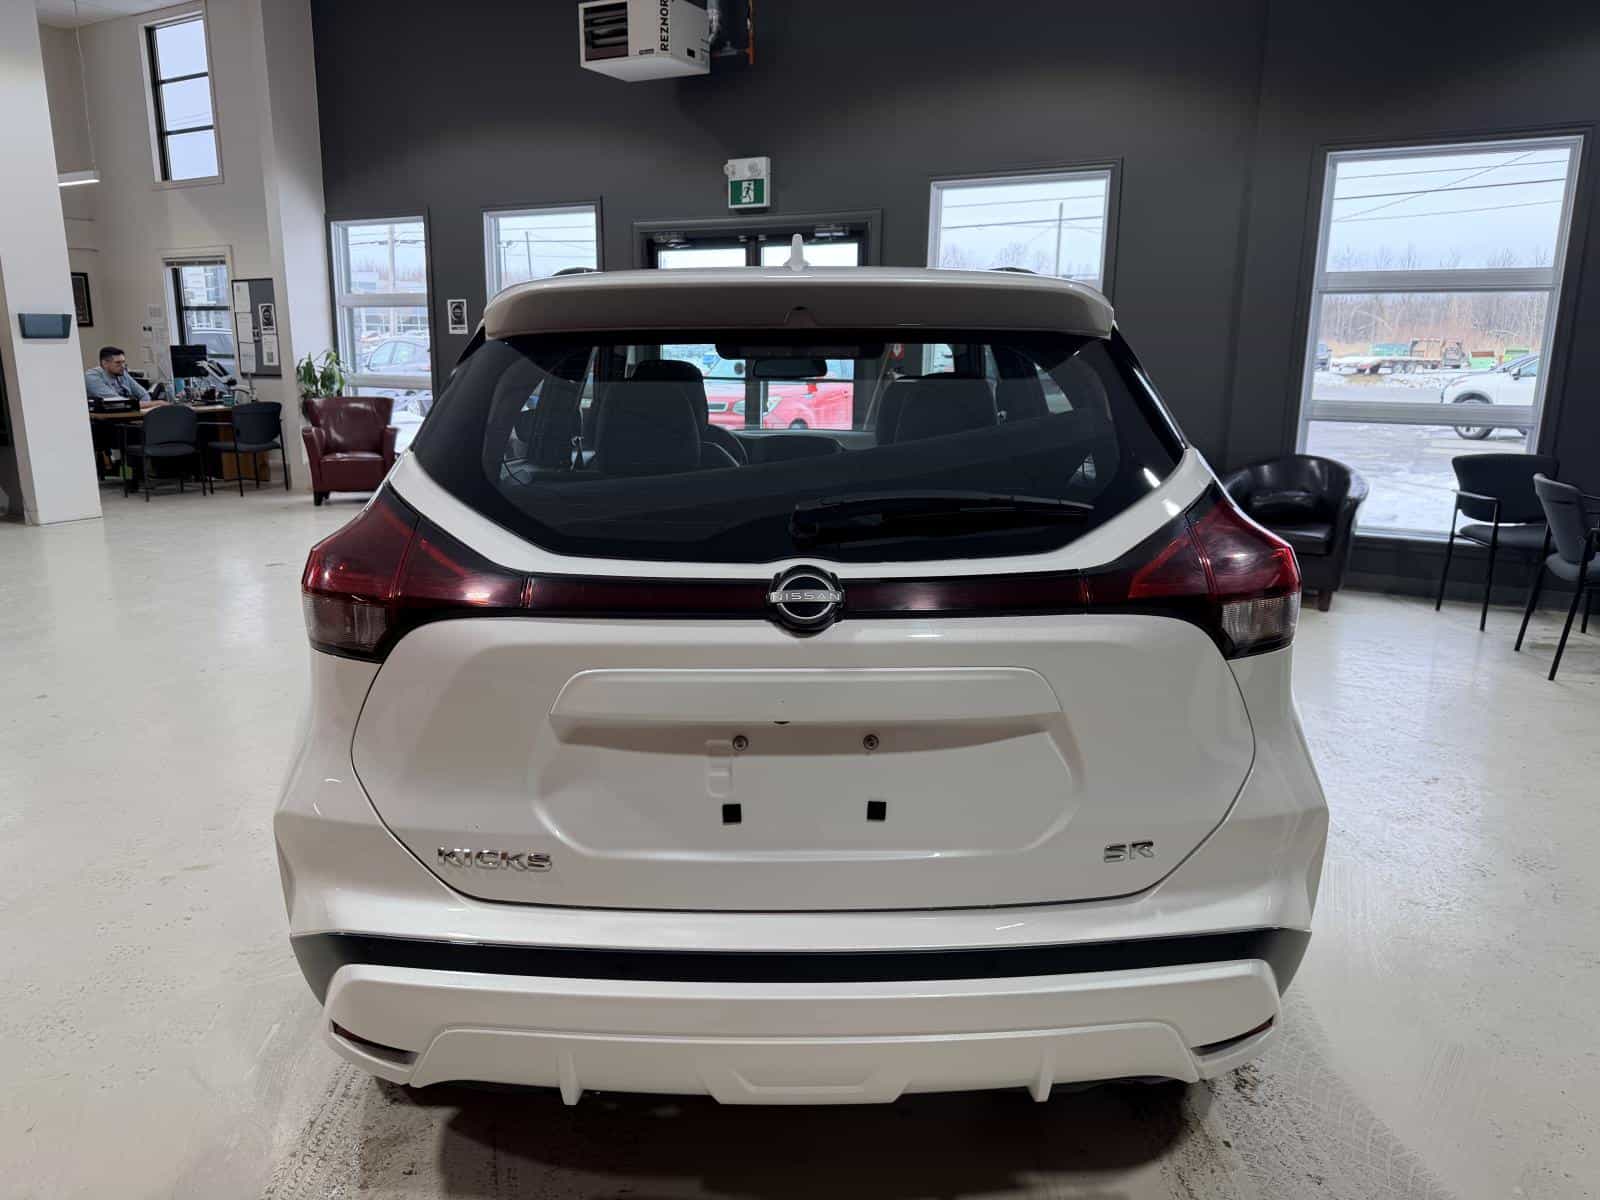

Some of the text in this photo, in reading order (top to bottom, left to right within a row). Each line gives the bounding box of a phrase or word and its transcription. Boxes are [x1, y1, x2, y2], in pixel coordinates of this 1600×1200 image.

[660, 0, 669, 51] REZNOR
[770, 591, 840, 601] NISSAN
[437, 847, 553, 872] KICKS
[1103, 841, 1154, 863] SR
